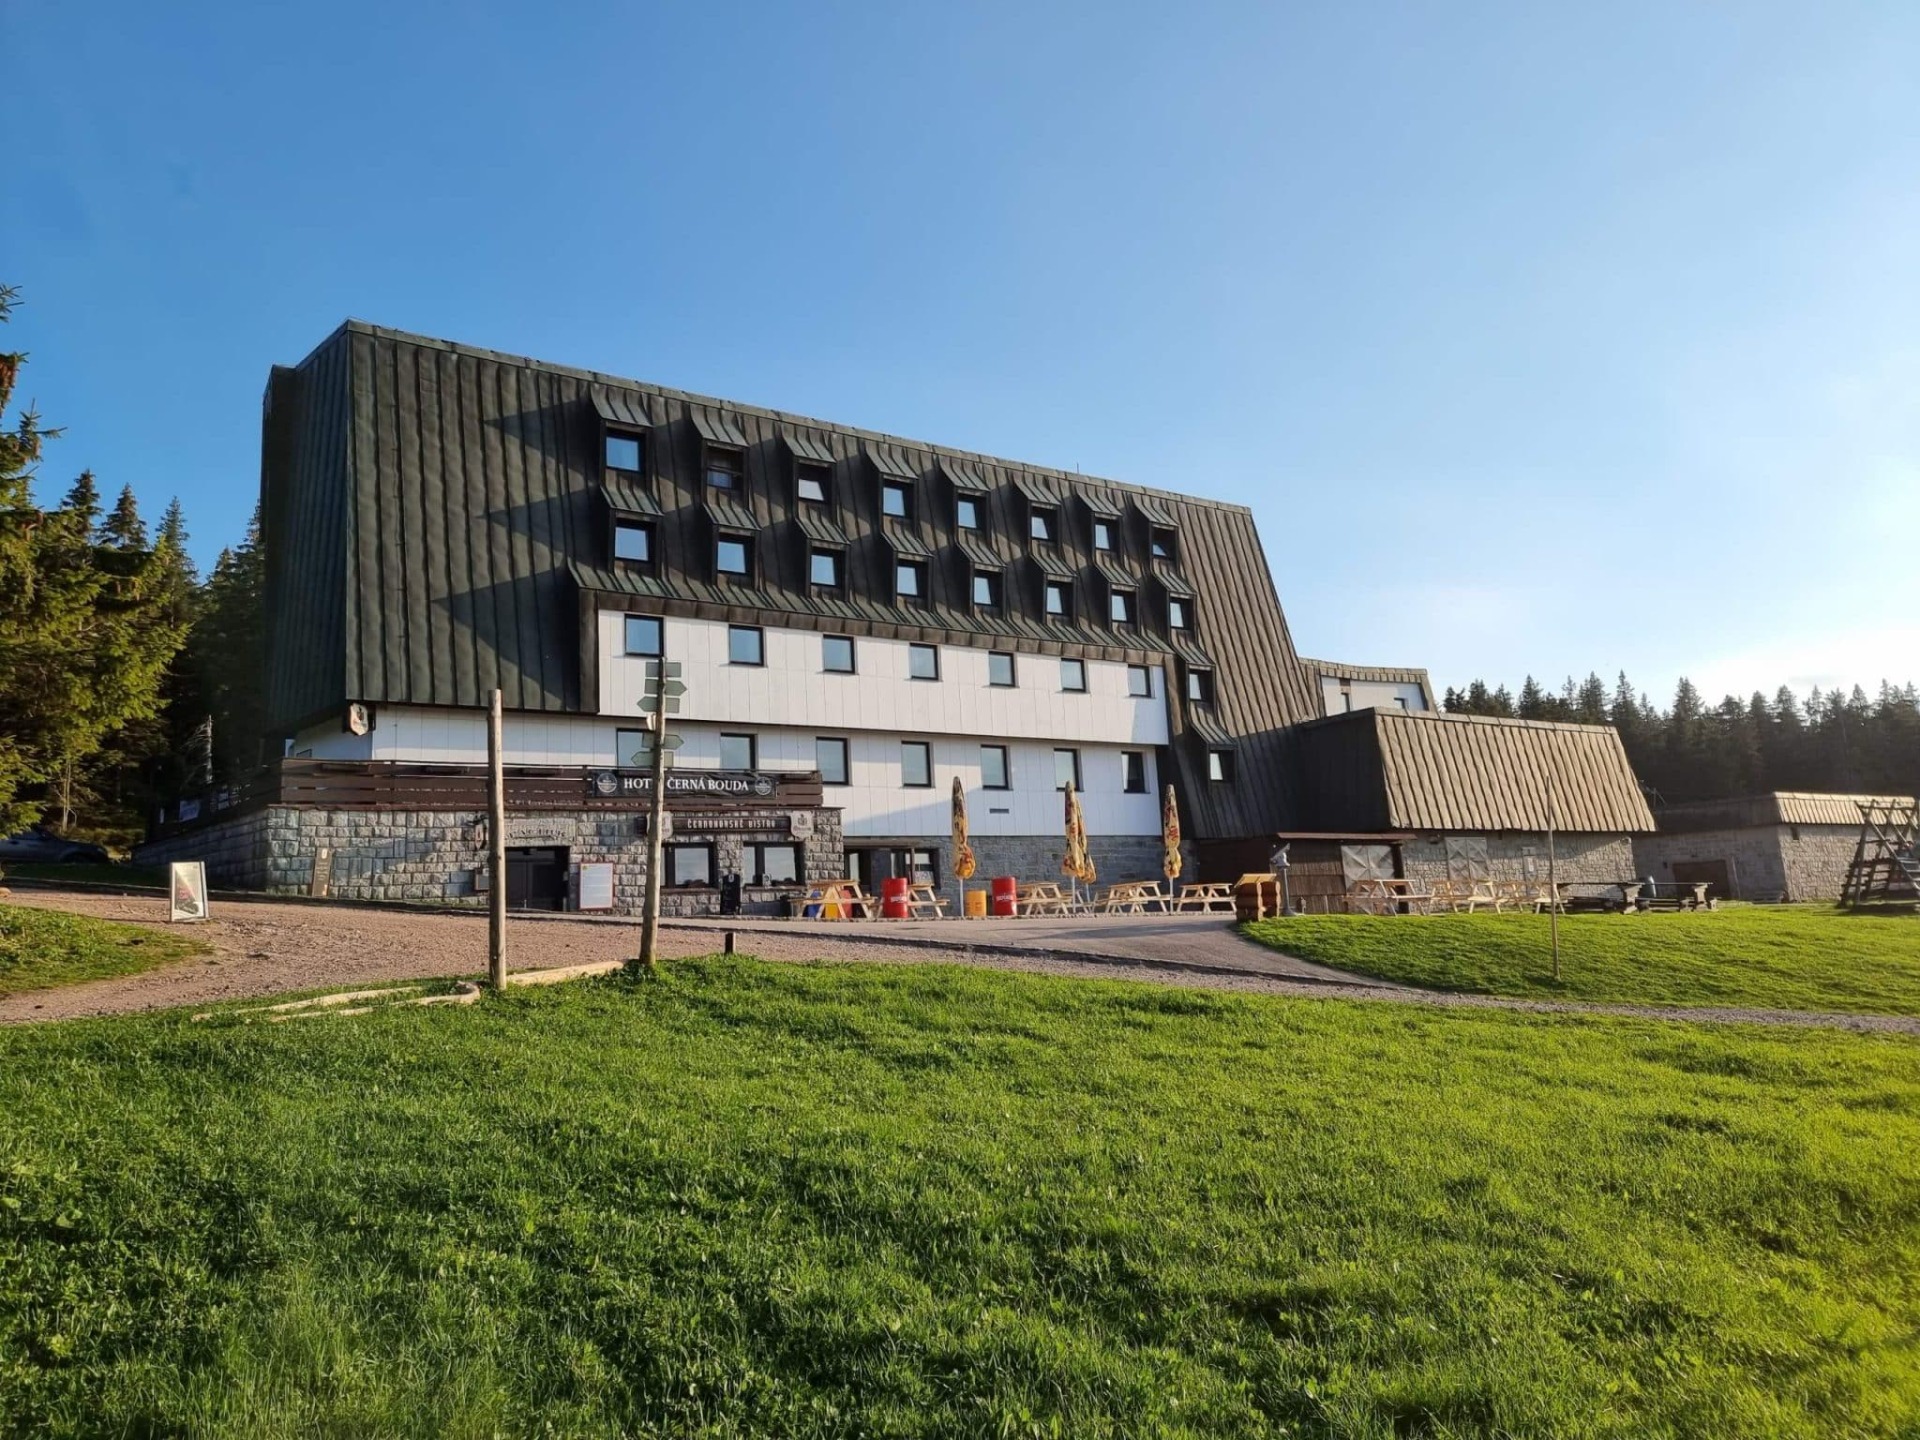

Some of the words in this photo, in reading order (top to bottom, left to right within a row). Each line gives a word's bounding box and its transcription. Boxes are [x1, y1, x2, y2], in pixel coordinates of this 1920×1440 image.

[623, 777, 654, 790] HOT
[666, 776, 706, 790] ČERNÁ
[707, 779, 749, 791] BOUDA
[748, 819, 776, 829] BISTRO
